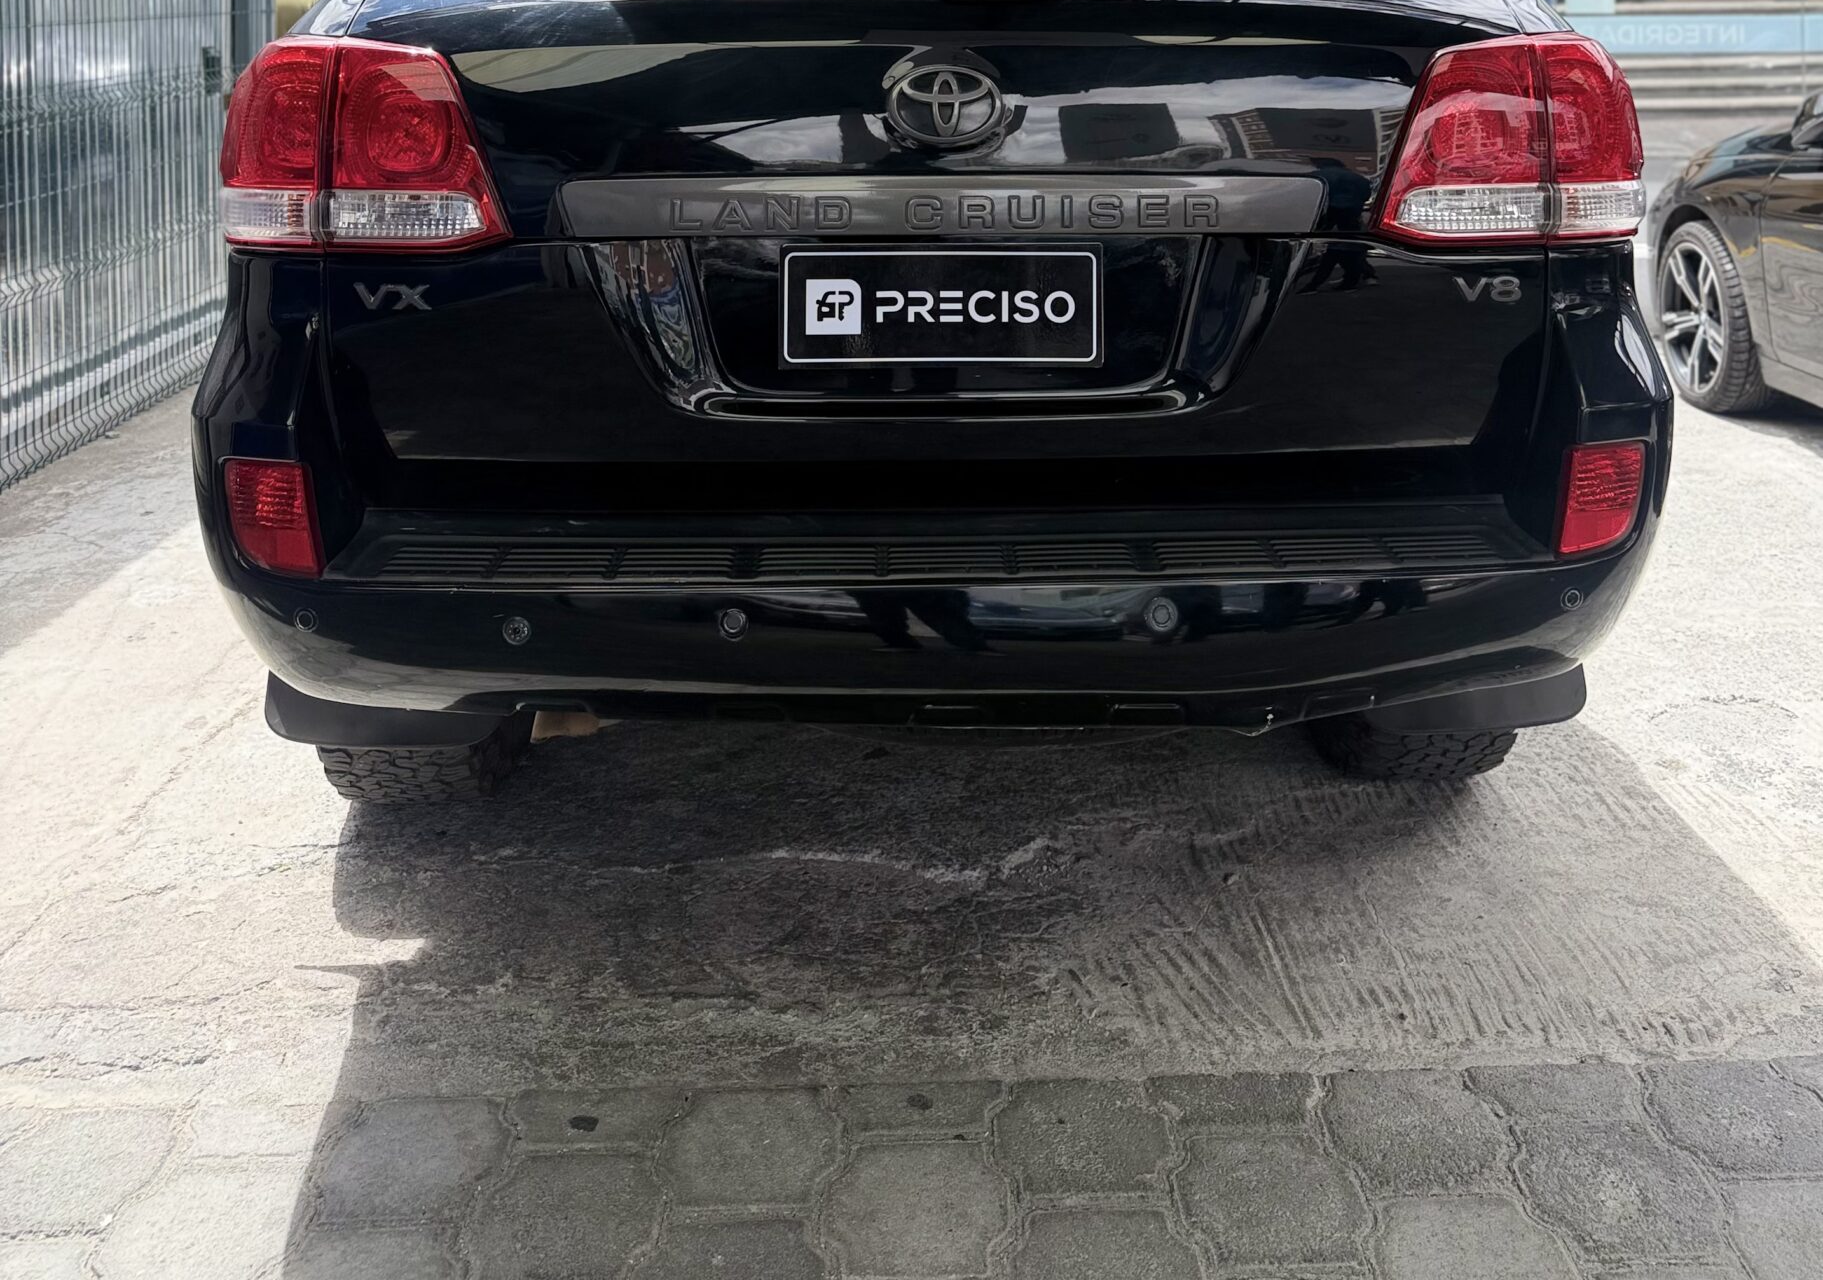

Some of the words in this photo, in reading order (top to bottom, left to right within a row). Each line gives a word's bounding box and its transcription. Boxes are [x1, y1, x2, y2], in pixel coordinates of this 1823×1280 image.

[669, 196, 852, 231] LAND
[904, 194, 1220, 230] CRUISER
[353, 282, 432, 310] VX
[1453, 276, 1522, 302] V8
[875, 290, 1076, 323] PRECISO
